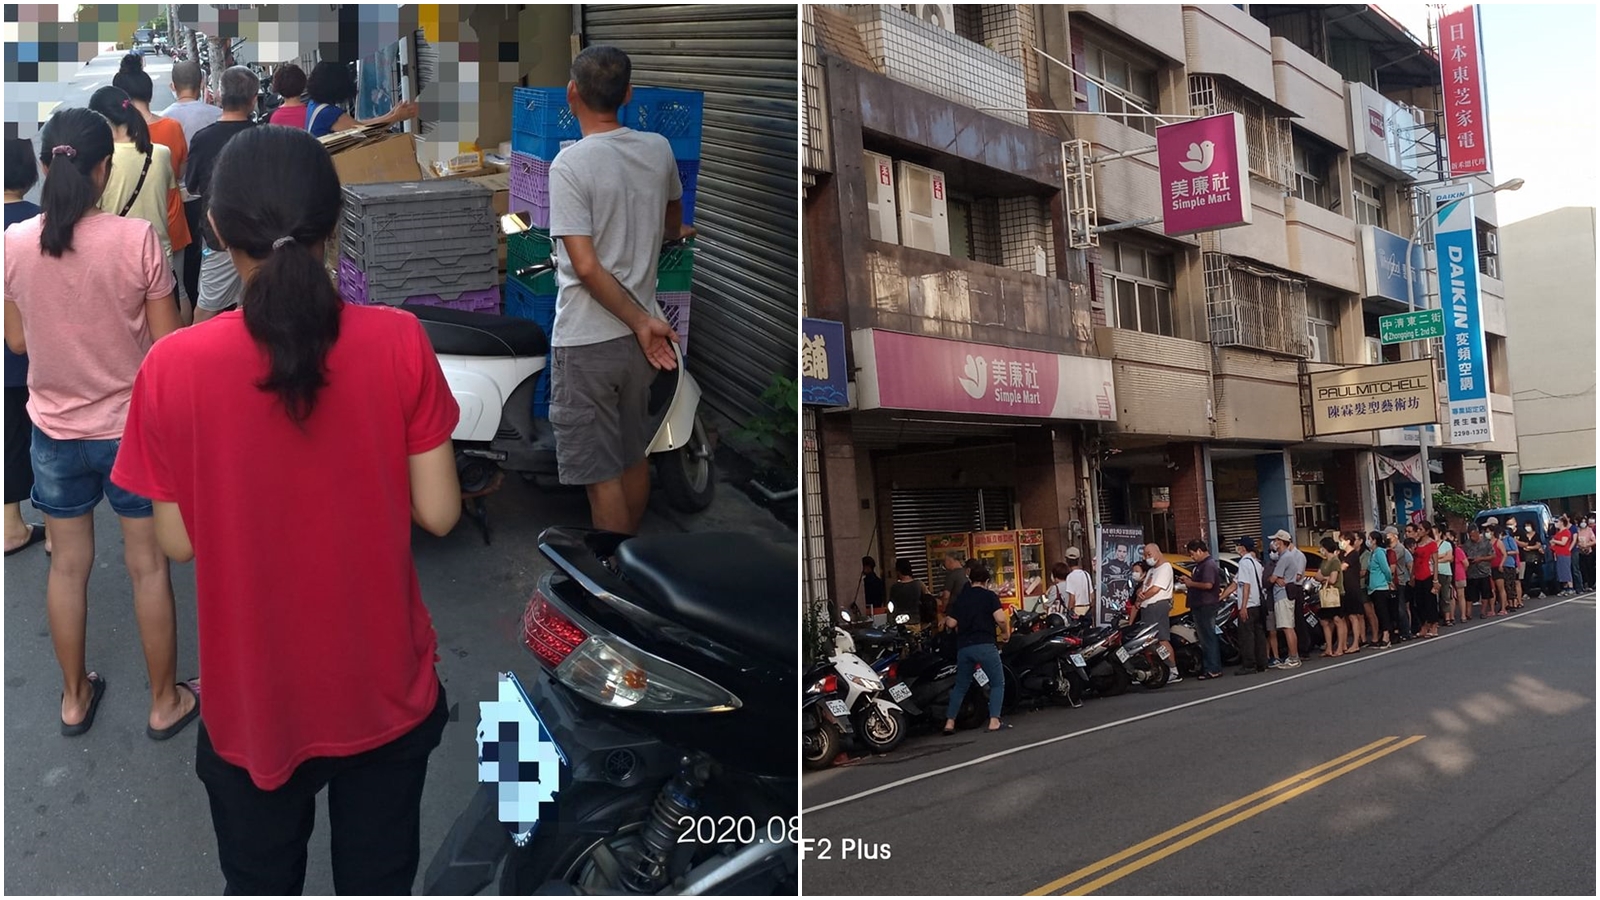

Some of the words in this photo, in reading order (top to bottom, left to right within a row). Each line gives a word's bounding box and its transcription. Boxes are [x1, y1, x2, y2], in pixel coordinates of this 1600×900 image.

[1450, 23, 1475, 149] 日本東芝家電
[1171, 171, 1230, 199] 美廉社
[1172, 196, 1206, 210] Simple
[1208, 191, 1231, 204] Mart
[1436, 191, 1465, 201] DAIKIN
[1448, 245, 1469, 329] DAIKIN
[1382, 312, 1441, 330] 中清東二街
[1388, 331, 1415, 340] Zhongqing
[1420, 328, 1430, 336] 2nd
[991, 359, 1040, 389] 美廉社
[994, 388, 1022, 406] Simple
[1022, 393, 1041, 405] Mart
[1327, 396, 1420, 419] 陳霖髮型藝術坊
[1453, 416, 1487, 427] 長生電器
[1453, 428, 1488, 437] 2298-1370
